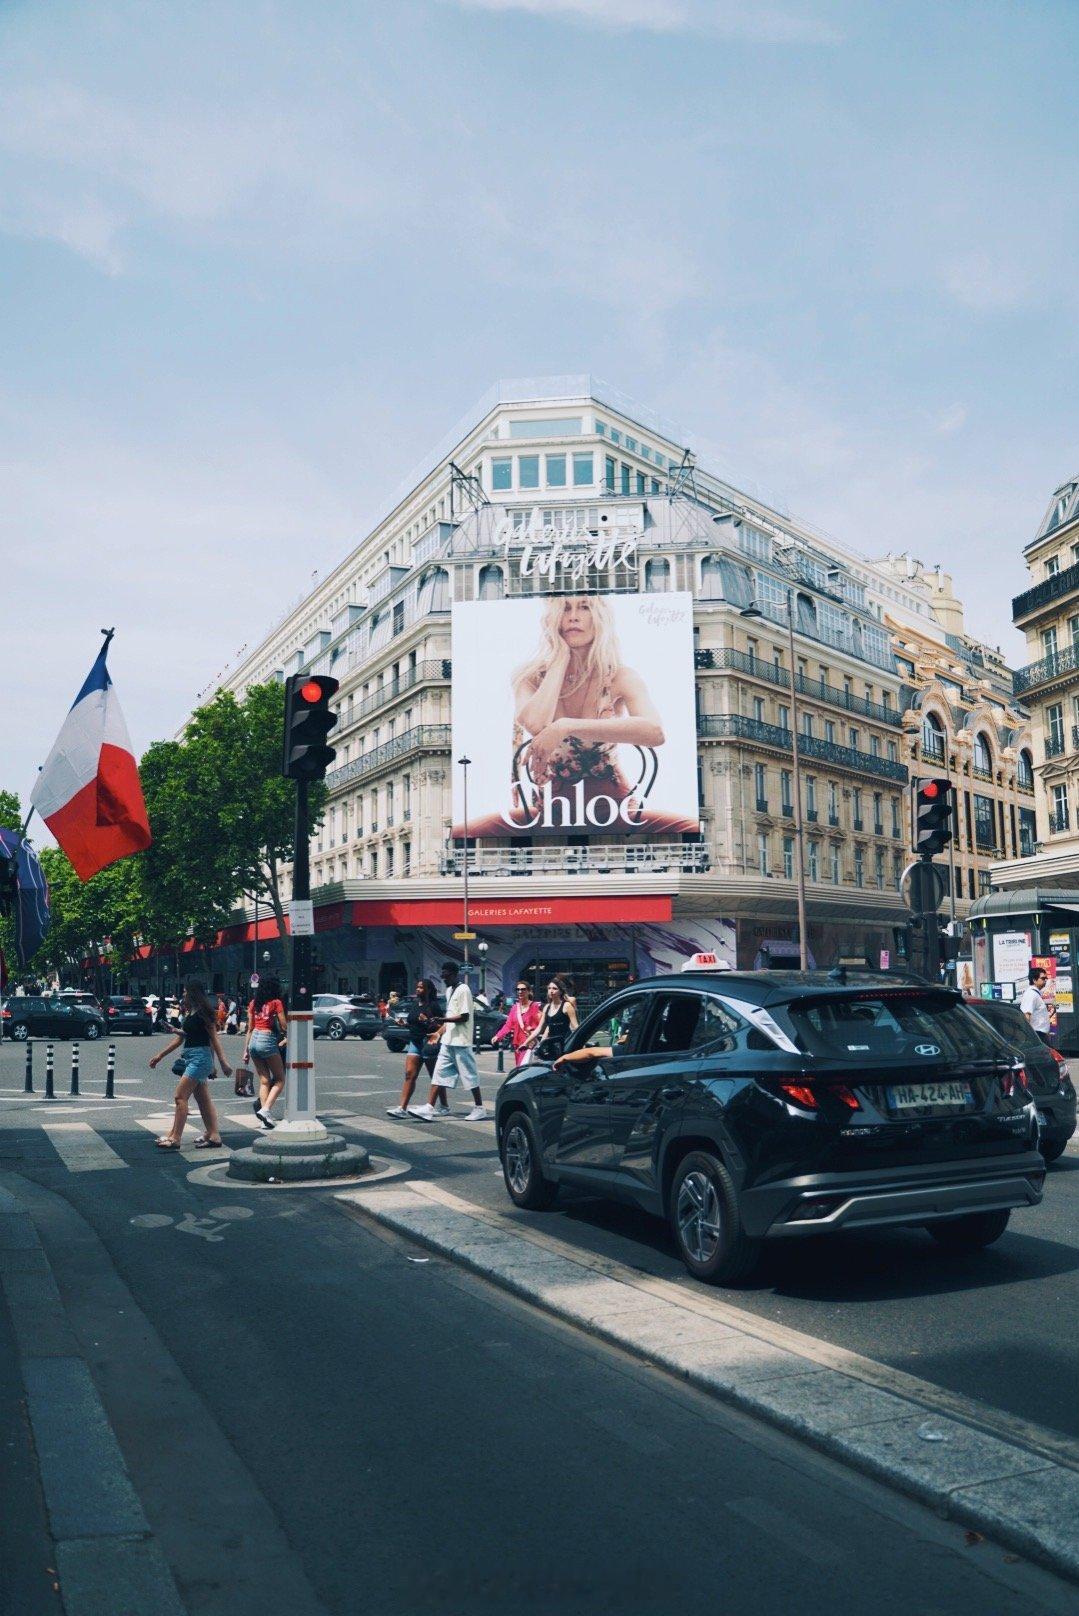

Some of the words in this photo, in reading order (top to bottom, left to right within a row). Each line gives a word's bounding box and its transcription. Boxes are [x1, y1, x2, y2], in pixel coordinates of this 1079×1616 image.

[520, 527, 646, 583] Lafayette
[467, 908, 507, 917] GALERIES
[508, 907, 553, 916] LAFAYETTE
[697, 954, 716, 964] TAXI
